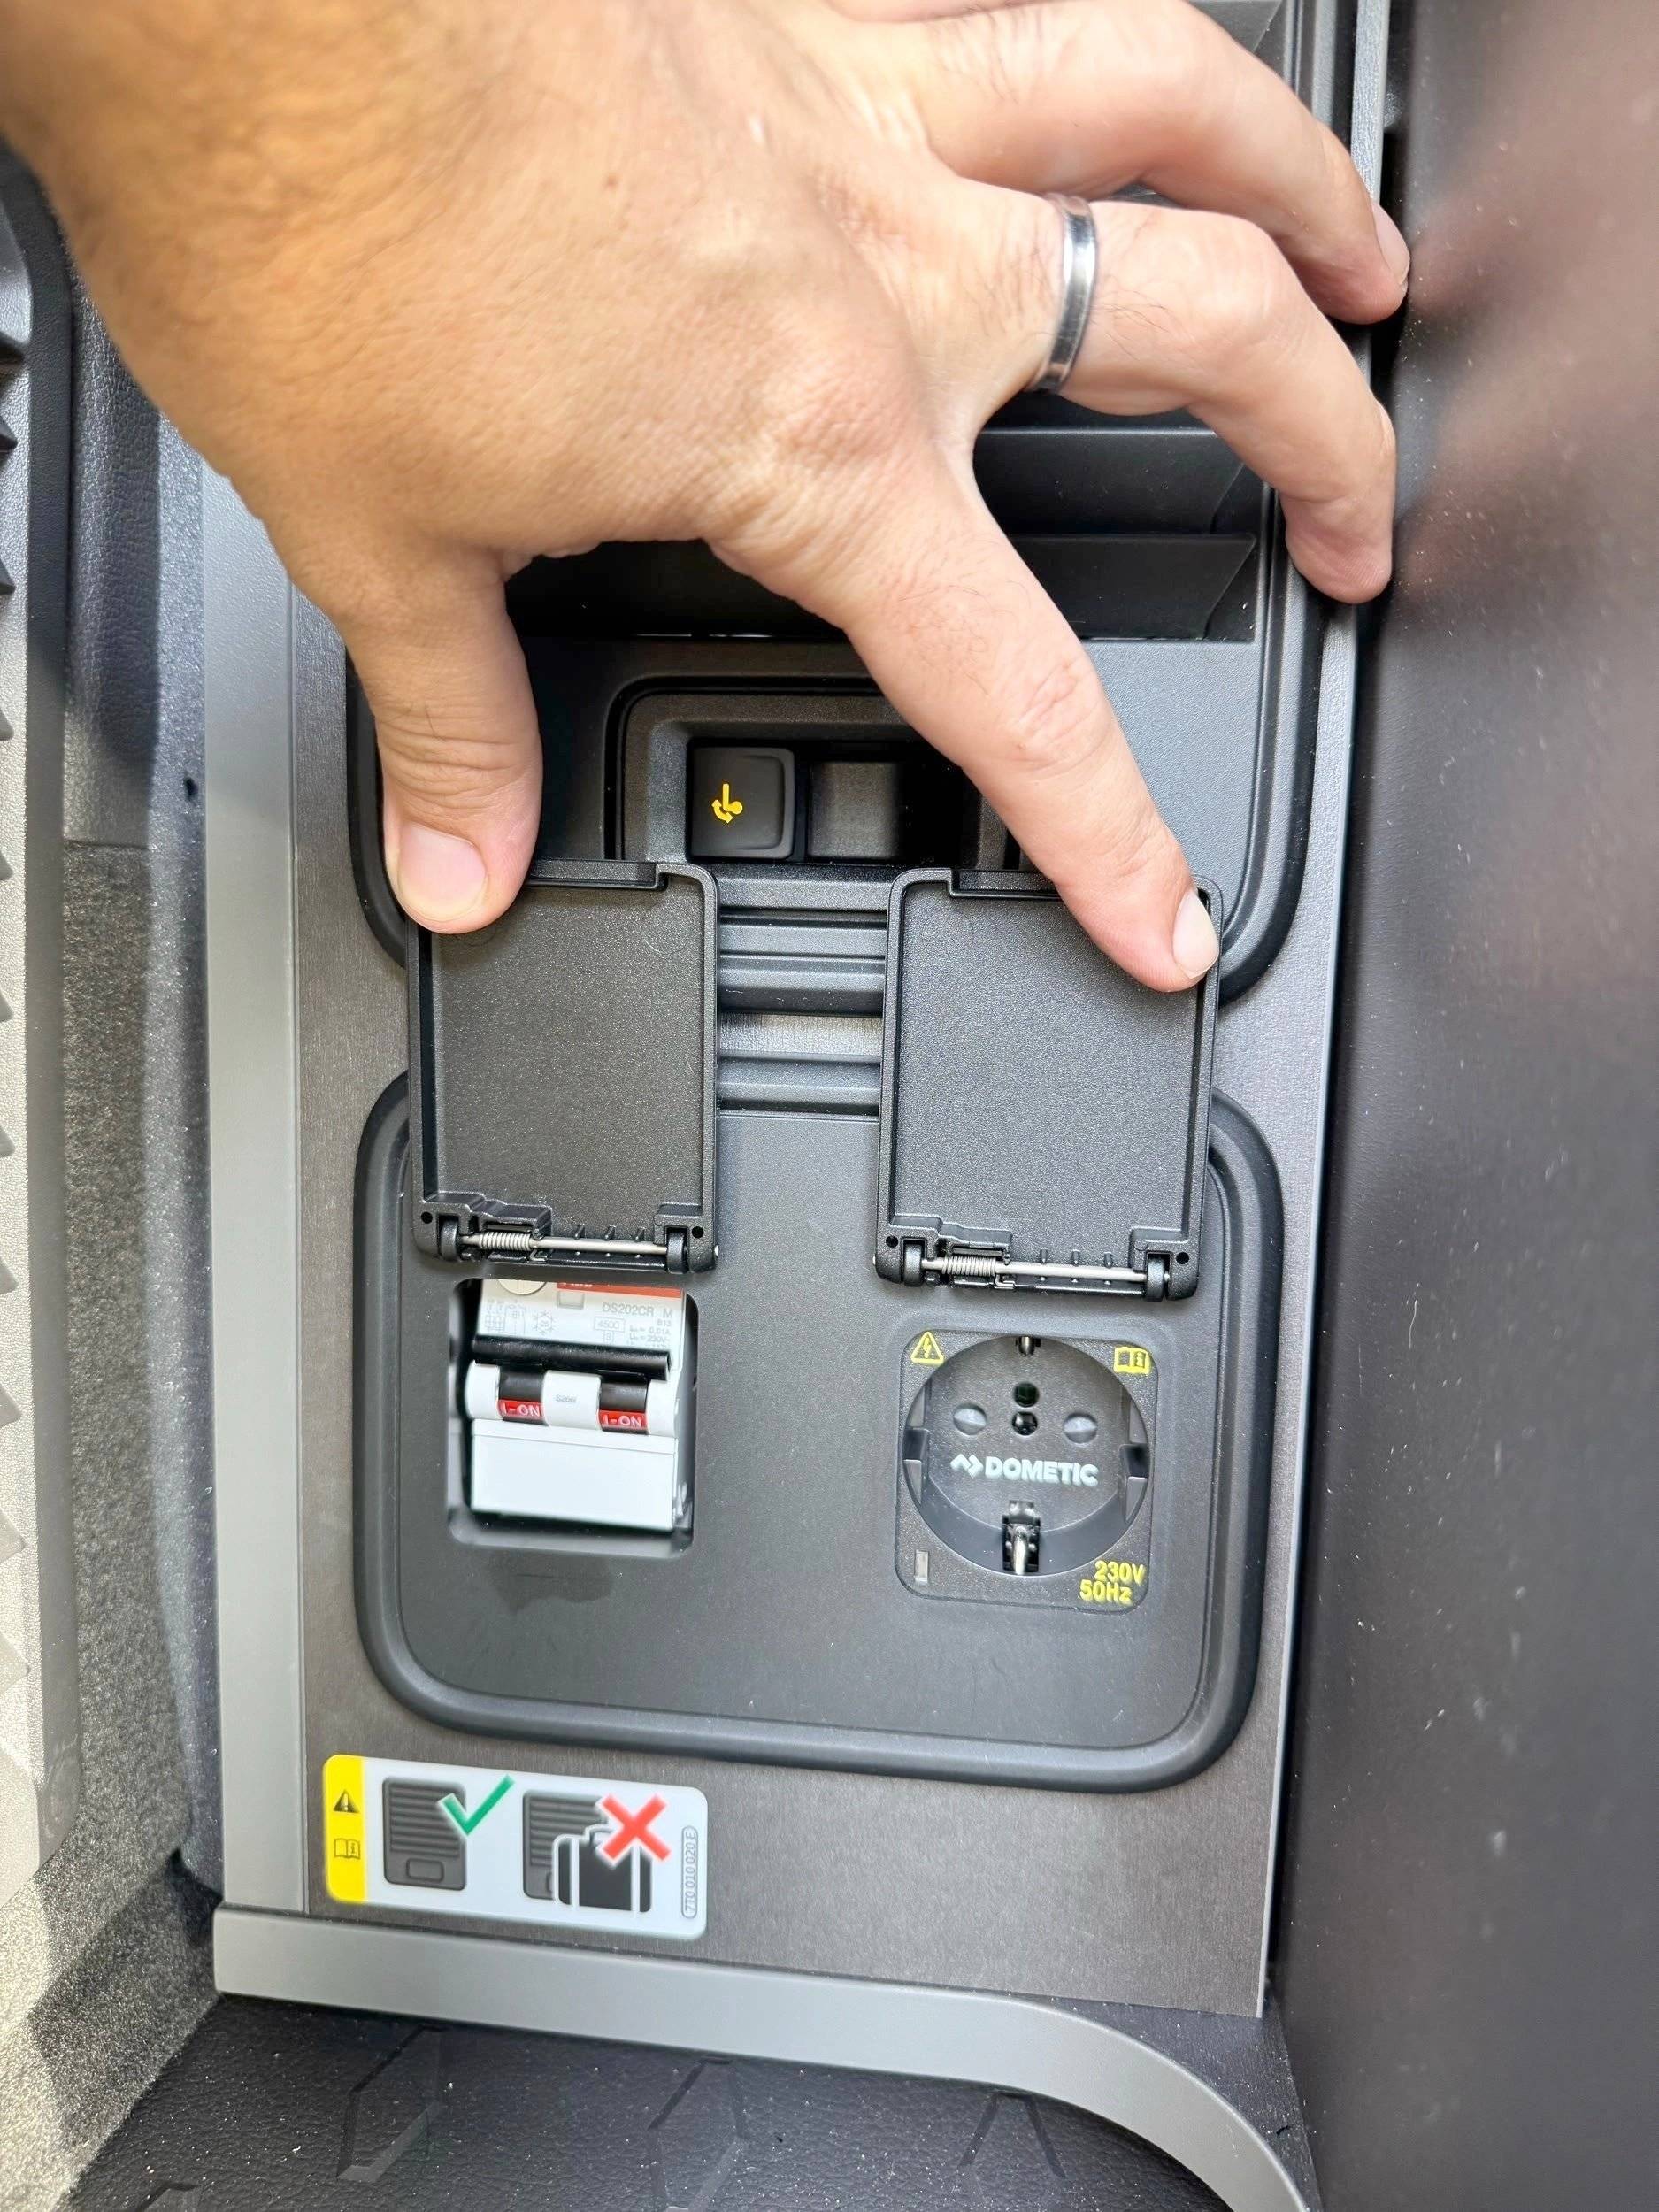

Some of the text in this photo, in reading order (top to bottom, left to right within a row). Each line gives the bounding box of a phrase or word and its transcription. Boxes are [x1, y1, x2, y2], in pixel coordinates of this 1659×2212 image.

[603, 1302, 672, 1318] DS202CR M
[597, 1319, 619, 1329] 4500
[985, 1456, 1099, 1486] DOMETIC
[1094, 1560, 1146, 1586] 230V
[1079, 1579, 1133, 1606] 50Hz
[686, 1832, 695, 1840] E
[685, 1867, 695, 1888] 010
